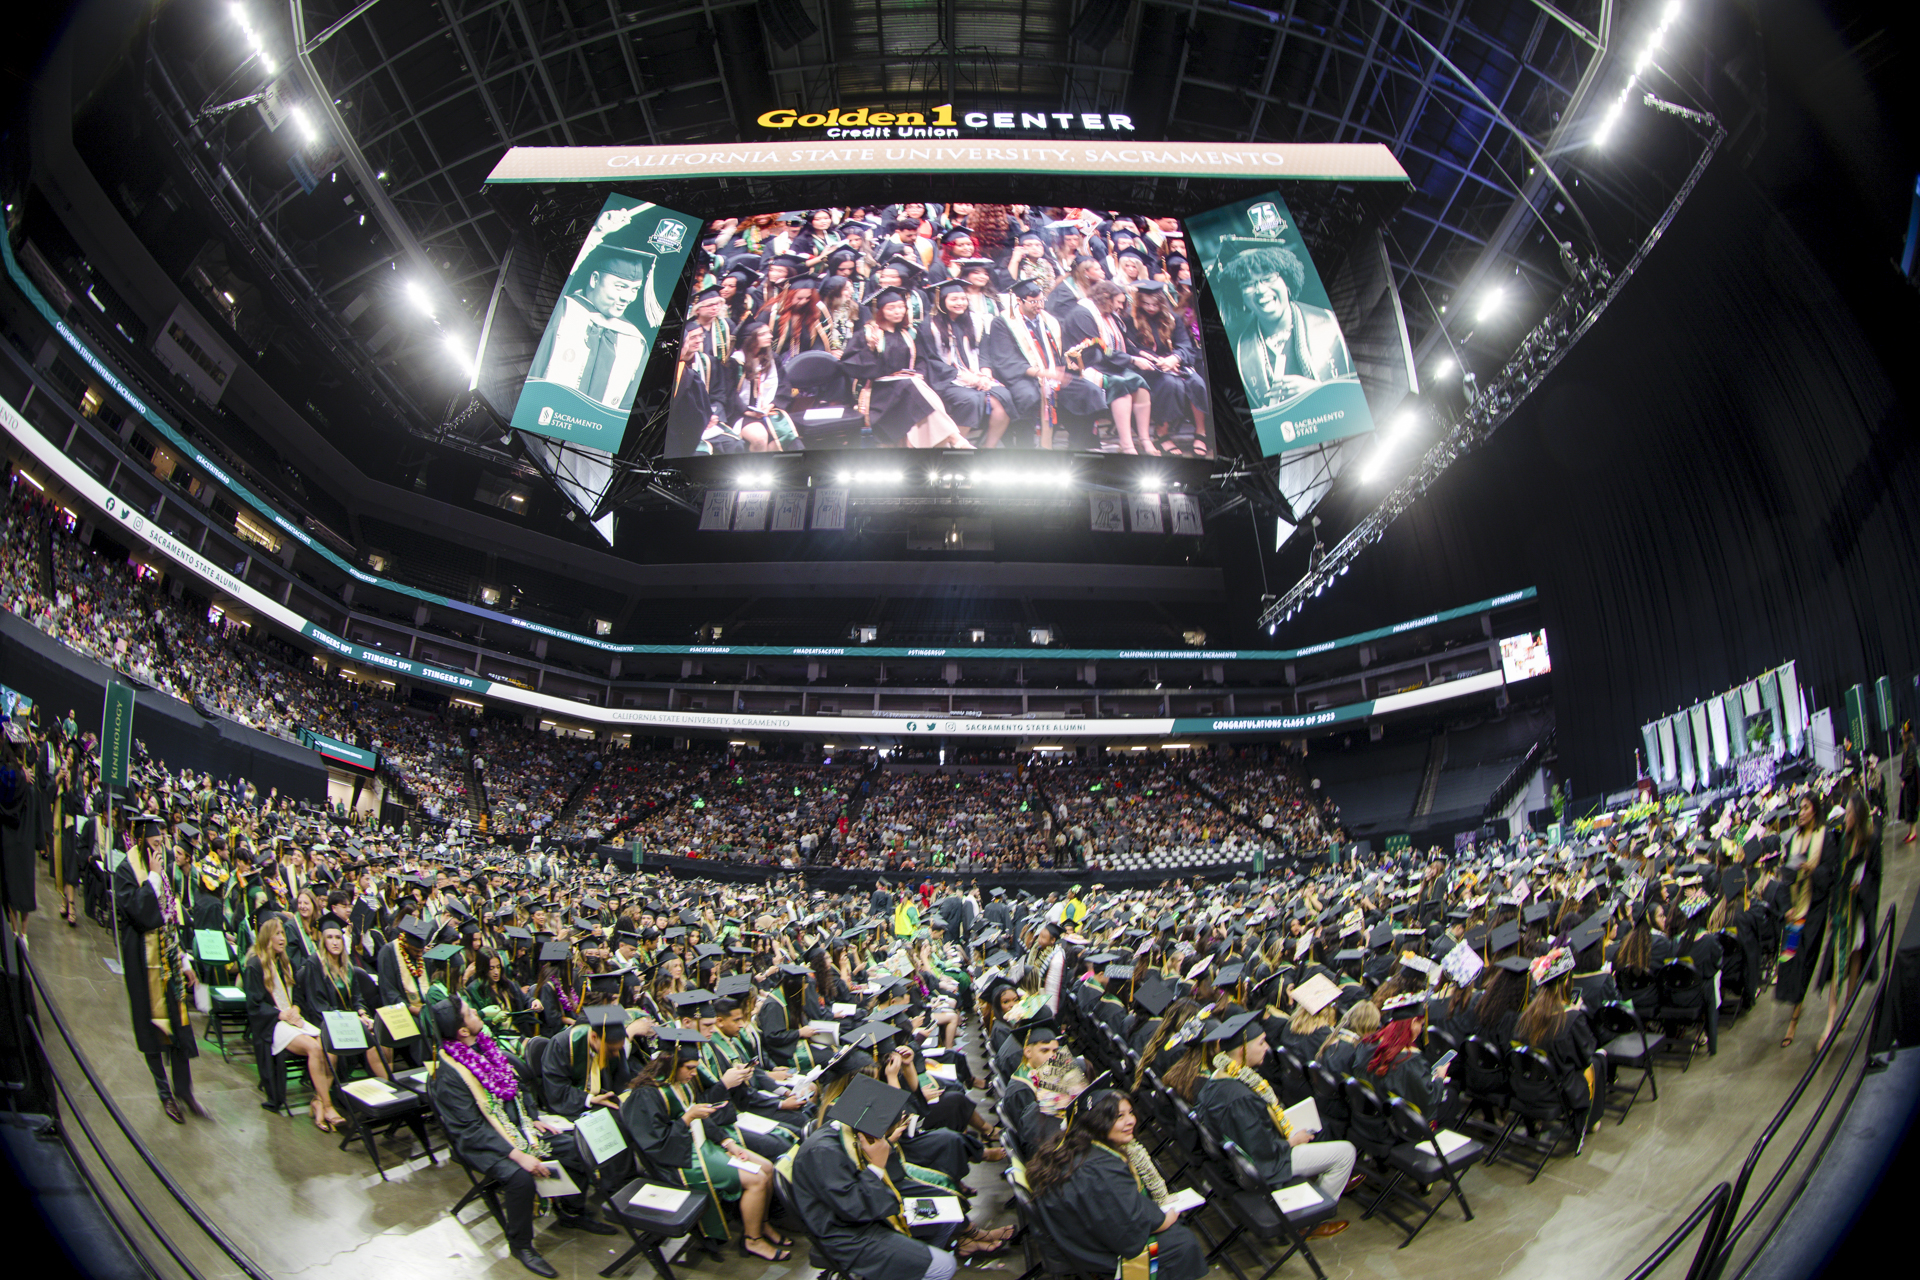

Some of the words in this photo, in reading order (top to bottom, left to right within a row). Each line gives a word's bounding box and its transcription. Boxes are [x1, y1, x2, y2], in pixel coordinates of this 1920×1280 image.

[964, 112, 1135, 131] CENTER
[827, 127, 890, 138] Credit
[898, 126, 959, 138] Union
[607, 150, 780, 168] CALIFORNIA
[788, 148, 874, 163] STATE
[885, 148, 1075, 163] UNIVERSITY,
[1084, 149, 1284, 166] SACRAMENTO
[1251, 204, 1275, 226] 75
[660, 220, 684, 240] 75
[56, 321, 82, 352] CALIFORNIA
[80, 346, 94, 364] STATE
[116, 383, 146, 414] SACRAMENTO
[551, 419, 572, 431] STATE
[554, 411, 603, 431] SACRAMENTO
[1294, 410, 1345, 429] SACRAMENTO
[1296, 425, 1318, 438] STATE
[196, 454, 229, 484] #SACSTATEGRAD
[149, 530, 194, 564] SACRAMENTO
[194, 560, 215, 578] STATE
[215, 573, 242, 594] ALUMNI
[349, 568, 378, 583] #STINGERSUP
[312, 629, 340, 649] STINGERS
[340, 644, 353, 655] UP!
[526, 622, 556, 635] CALIFORNIA
[556, 630, 571, 640] STATE
[601, 643, 634, 652] SACRAMENTO
[362, 651, 398, 667] STINGERS
[398, 660, 412, 671] UP!
[1202, 651, 1237, 659] SACRAMENTO
[422, 668, 459, 684] STINGERS
[459, 677, 473, 688] UP!
[612, 712, 657, 722] CALIFORNIA
[659, 714, 680, 723] STATE
[682, 716, 730, 725] UNIVERSITY,
[732, 717, 790, 728] SACRAMENTO
[965, 723, 1023, 731] SACRAMENTO
[1212, 719, 1282, 730] CONGRATULATIONS
[1282, 717, 1305, 728] CLASS
[1306, 715, 1316, 726] OF
[1317, 711, 1336, 724] 2023
[111, 700, 123, 780] KINESIOLOGY
